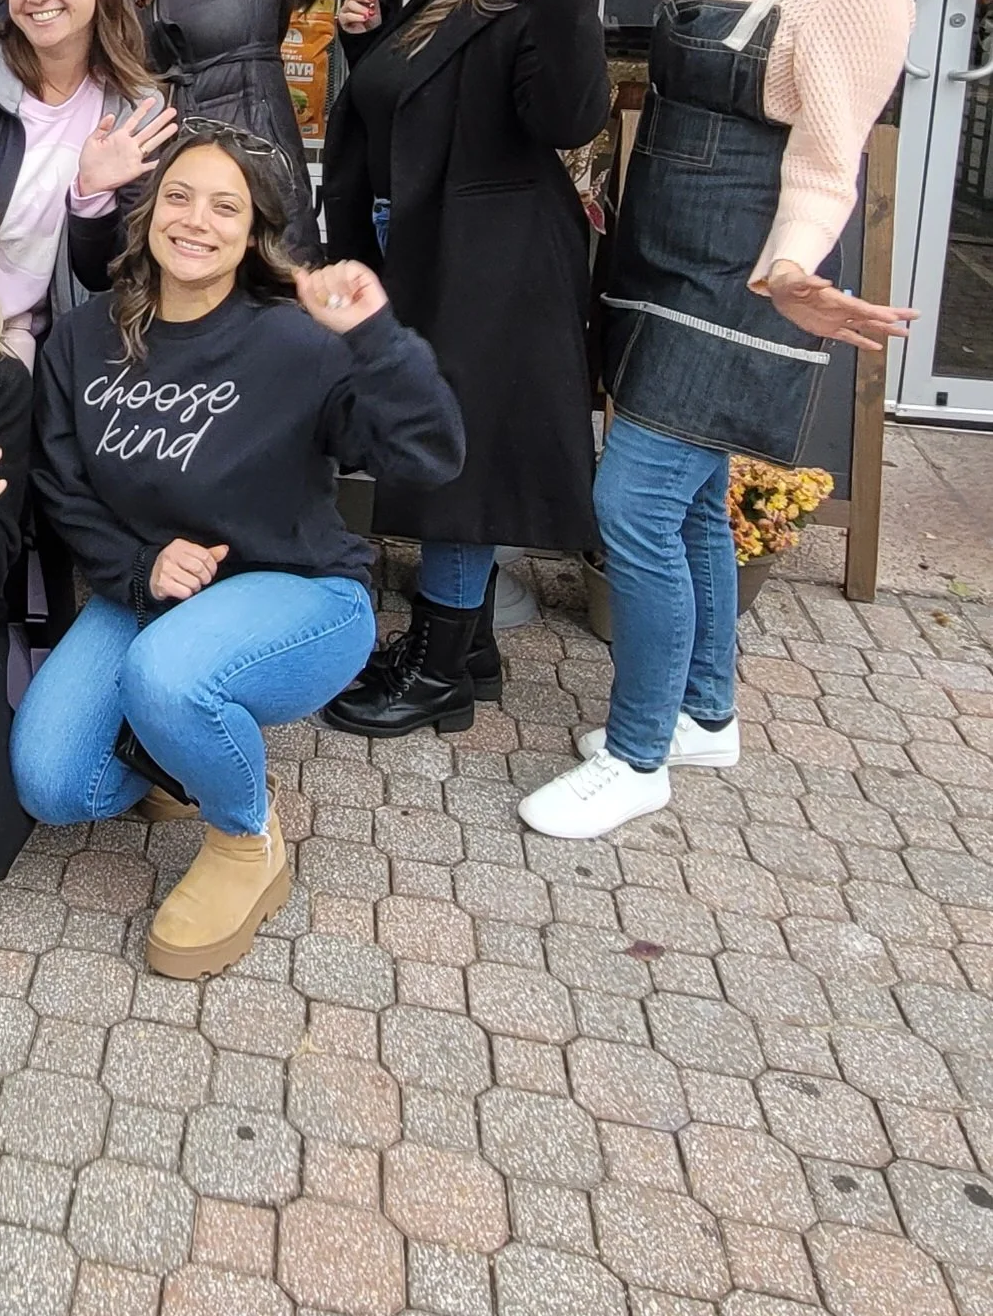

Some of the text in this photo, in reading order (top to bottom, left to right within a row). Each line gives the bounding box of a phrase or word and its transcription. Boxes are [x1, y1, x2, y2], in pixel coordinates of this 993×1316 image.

[286, 62, 314, 77] AYA
[84, 365, 240, 423] choose
[95, 408, 214, 473] kind
